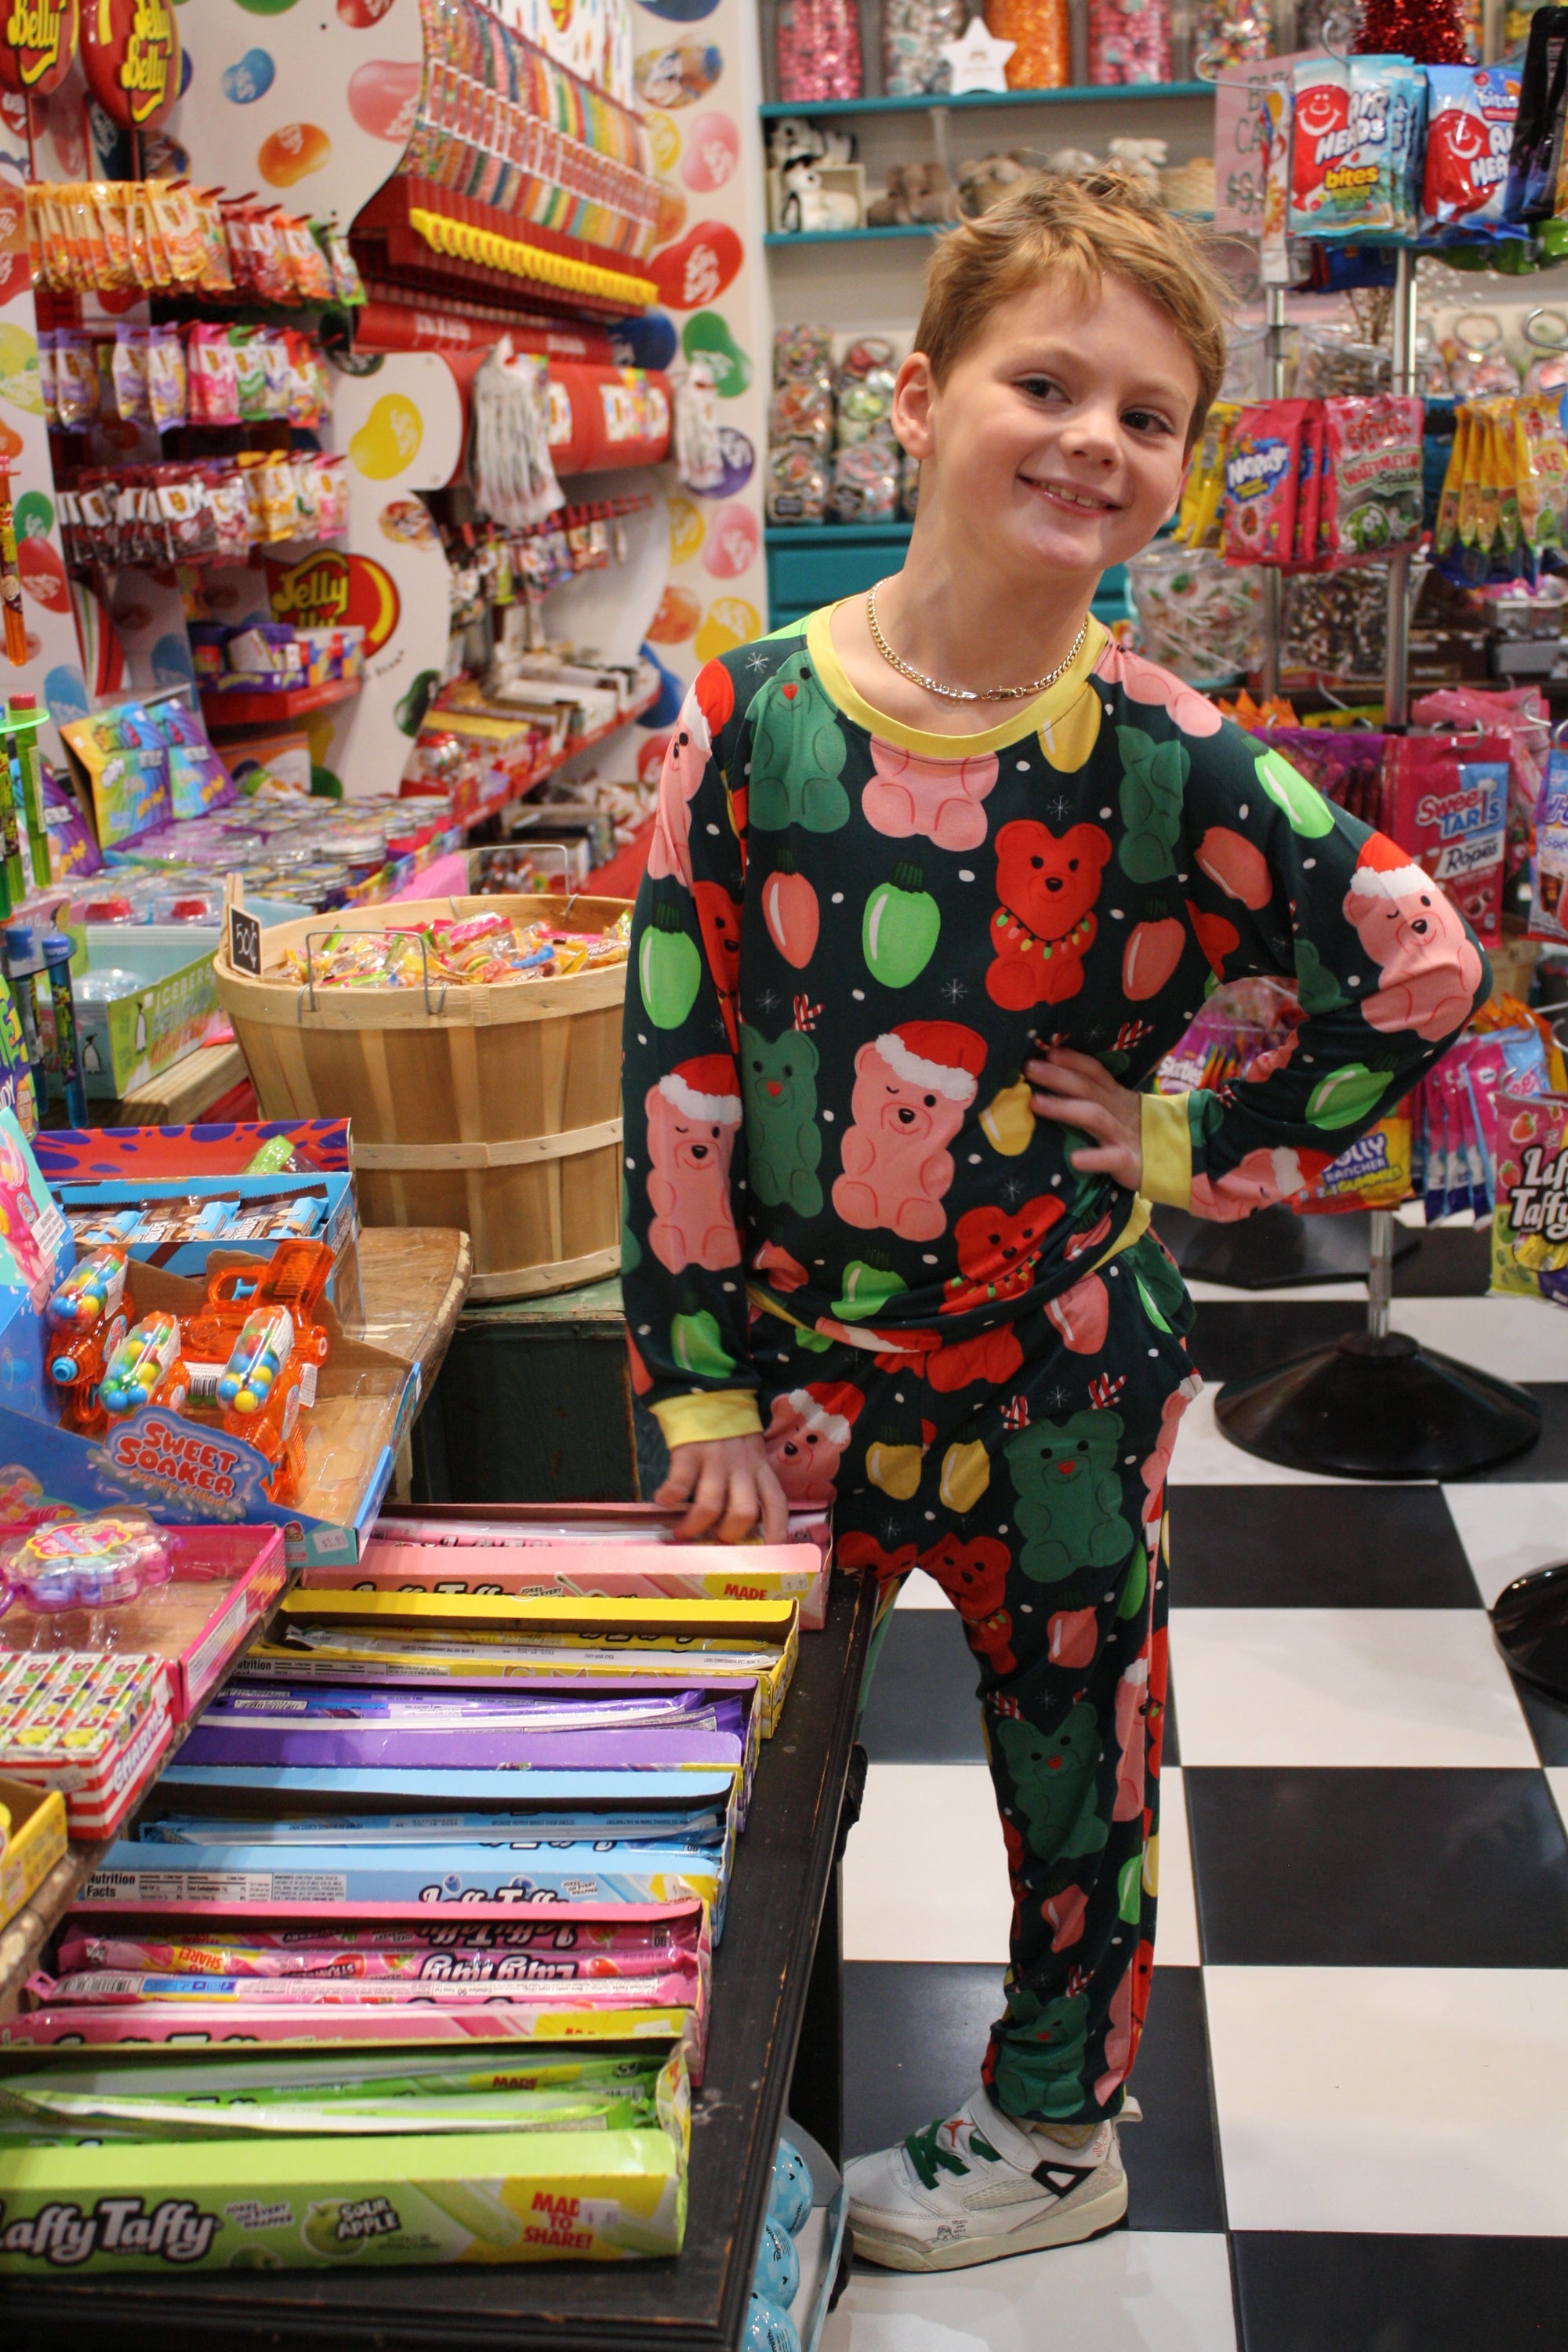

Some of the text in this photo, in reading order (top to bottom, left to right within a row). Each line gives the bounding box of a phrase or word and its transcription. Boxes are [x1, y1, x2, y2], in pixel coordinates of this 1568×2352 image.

[120, 34, 169, 122] Belly
[1347, 88, 1390, 122] AIR
[1314, 117, 1387, 166] HEADS
[1324, 165, 1380, 191] bites
[1469, 154, 1510, 187] HEA
[272, 550, 349, 618] Jelly
[1446, 844, 1499, 874] Ropes
[1323, 1134, 1385, 1173] OLLY
[1325, 1156, 1386, 1182] RANCHER
[143, 1421, 238, 1475] SWEET
[115, 1436, 234, 1499] SOAKER
[724, 1583, 768, 1600] MADE
[235, 1661, 272, 1671] utrition
[76, 1663, 138, 1728] CHARMS
[113, 1704, 166, 1792] CHARMS
[86, 1885, 116, 1898] Facts
[572, 1888, 598, 1896] WRAPPER
[177, 1947, 223, 1970] SHARE!
[457, 1987, 468, 1996] 90
[341, 2197, 390, 2219] SOUR
[530, 2191, 580, 2218] MAD
[2, 2200, 216, 2263] affy Taffy
[337, 2212, 399, 2239] APPLE
[549, 2215, 574, 2231] TO
[522, 2225, 594, 2250] SHARE!
